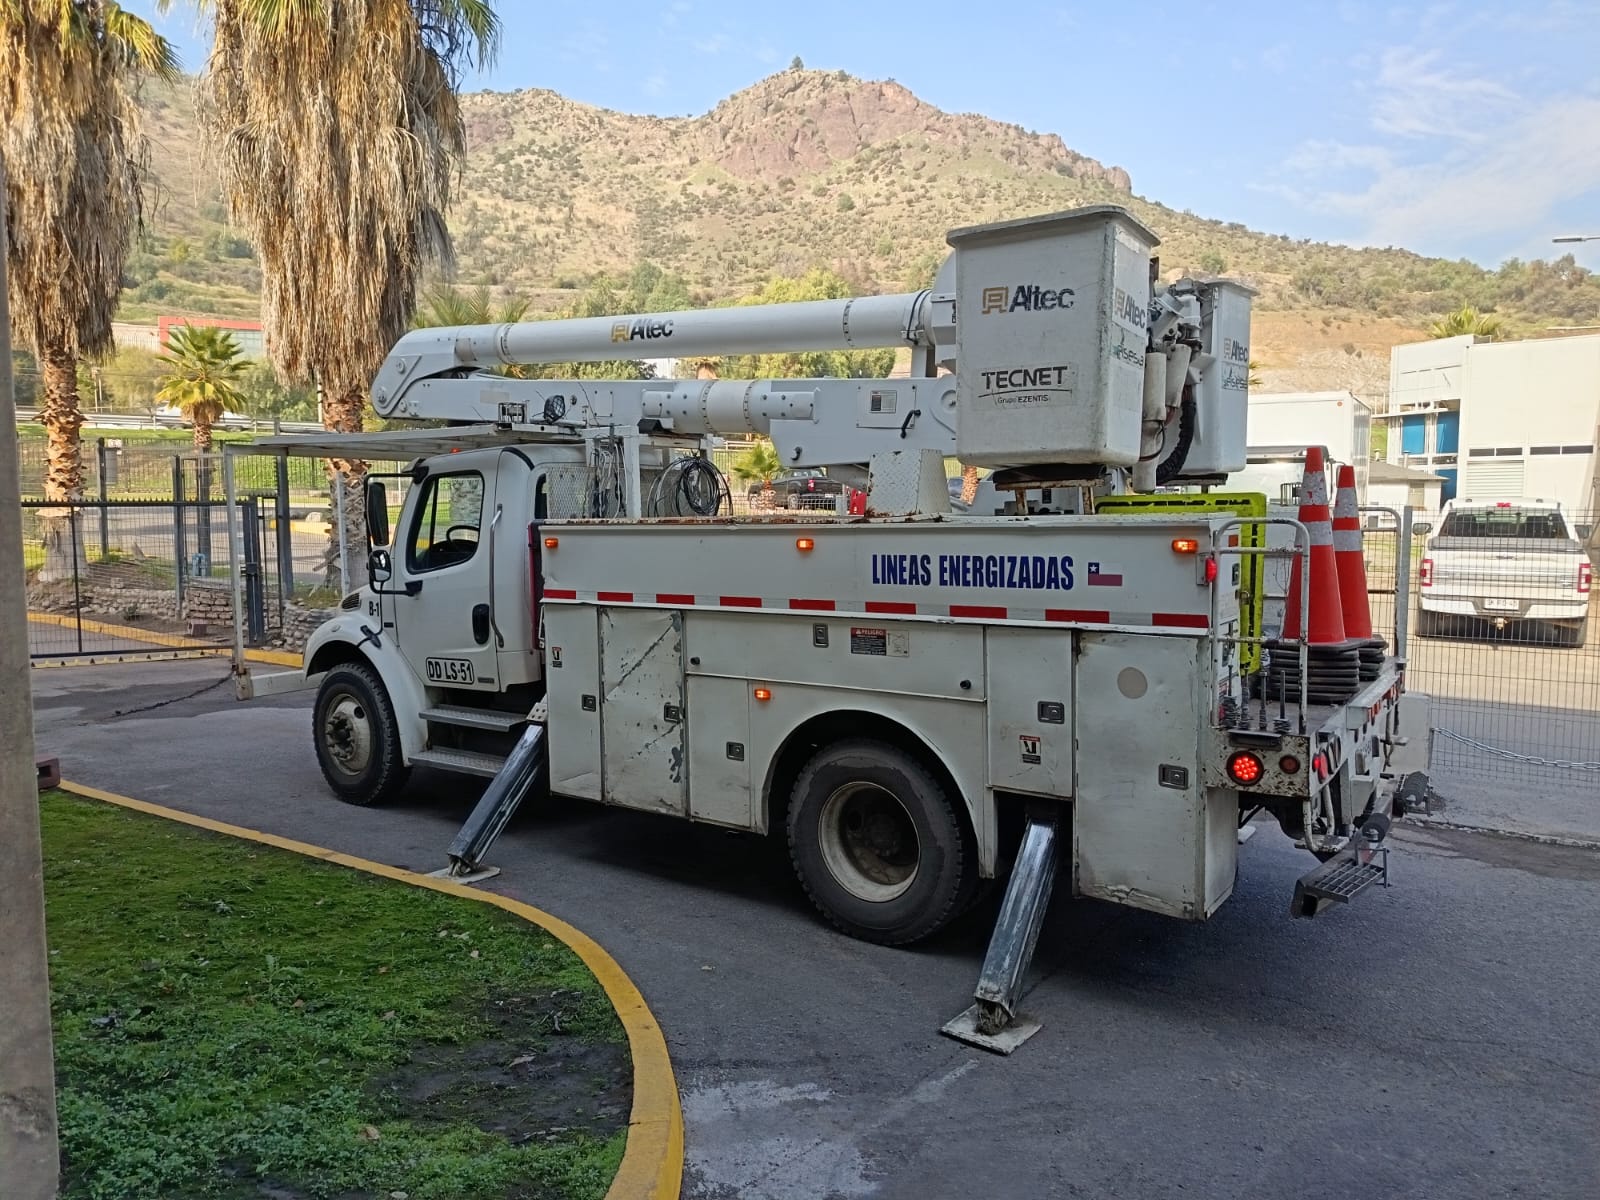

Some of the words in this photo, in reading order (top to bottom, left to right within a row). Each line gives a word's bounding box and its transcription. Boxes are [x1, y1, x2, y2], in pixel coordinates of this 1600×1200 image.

[1009, 285, 1075, 313] Altec
[1124, 295, 1146, 330] Altec
[630, 319, 674, 341] Altec
[1231, 339, 1248, 362] Altec
[981, 366, 1068, 390] TECNET
[1018, 394, 1049, 404] EZENTIS
[872, 554, 931, 586] LINEAS
[939, 555, 1074, 590] ENERGIZADAS
[368, 600, 380, 617] B-1
[427, 661, 442, 679] DD
